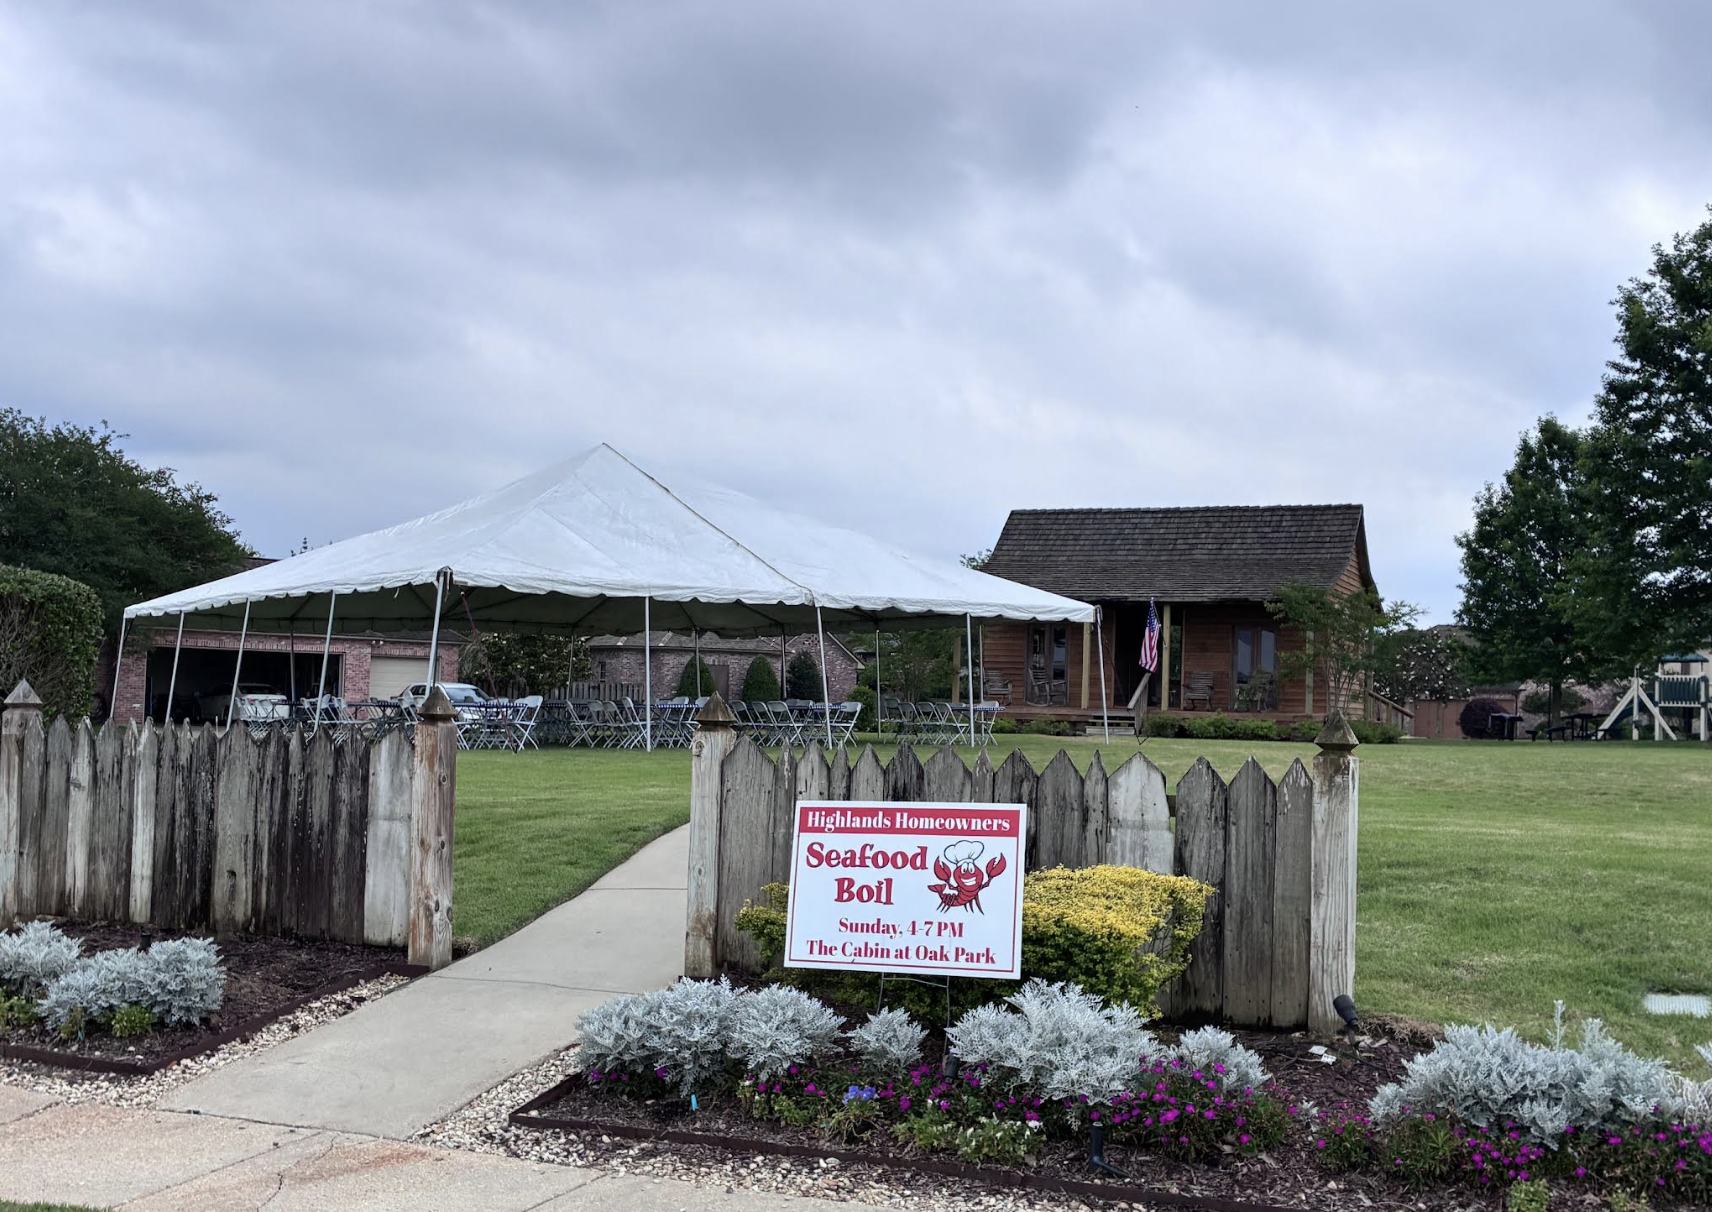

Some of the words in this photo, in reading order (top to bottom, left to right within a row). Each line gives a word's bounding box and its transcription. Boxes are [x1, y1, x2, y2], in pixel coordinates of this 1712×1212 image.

[807, 810, 891, 832] Highlands
[896, 812, 1010, 831] Homeowners
[806, 842, 928, 870] Seafood
[834, 877, 893, 905] Boil
[839, 918, 903, 939] Sunday,
[907, 921, 933, 936] 4-7
[937, 922, 963, 937] PM
[807, 940, 837, 956] The
[842, 942, 891, 959] Cabin
[894, 946, 910, 959] at
[916, 945, 950, 962] Oak
[954, 947, 996, 964] Park
